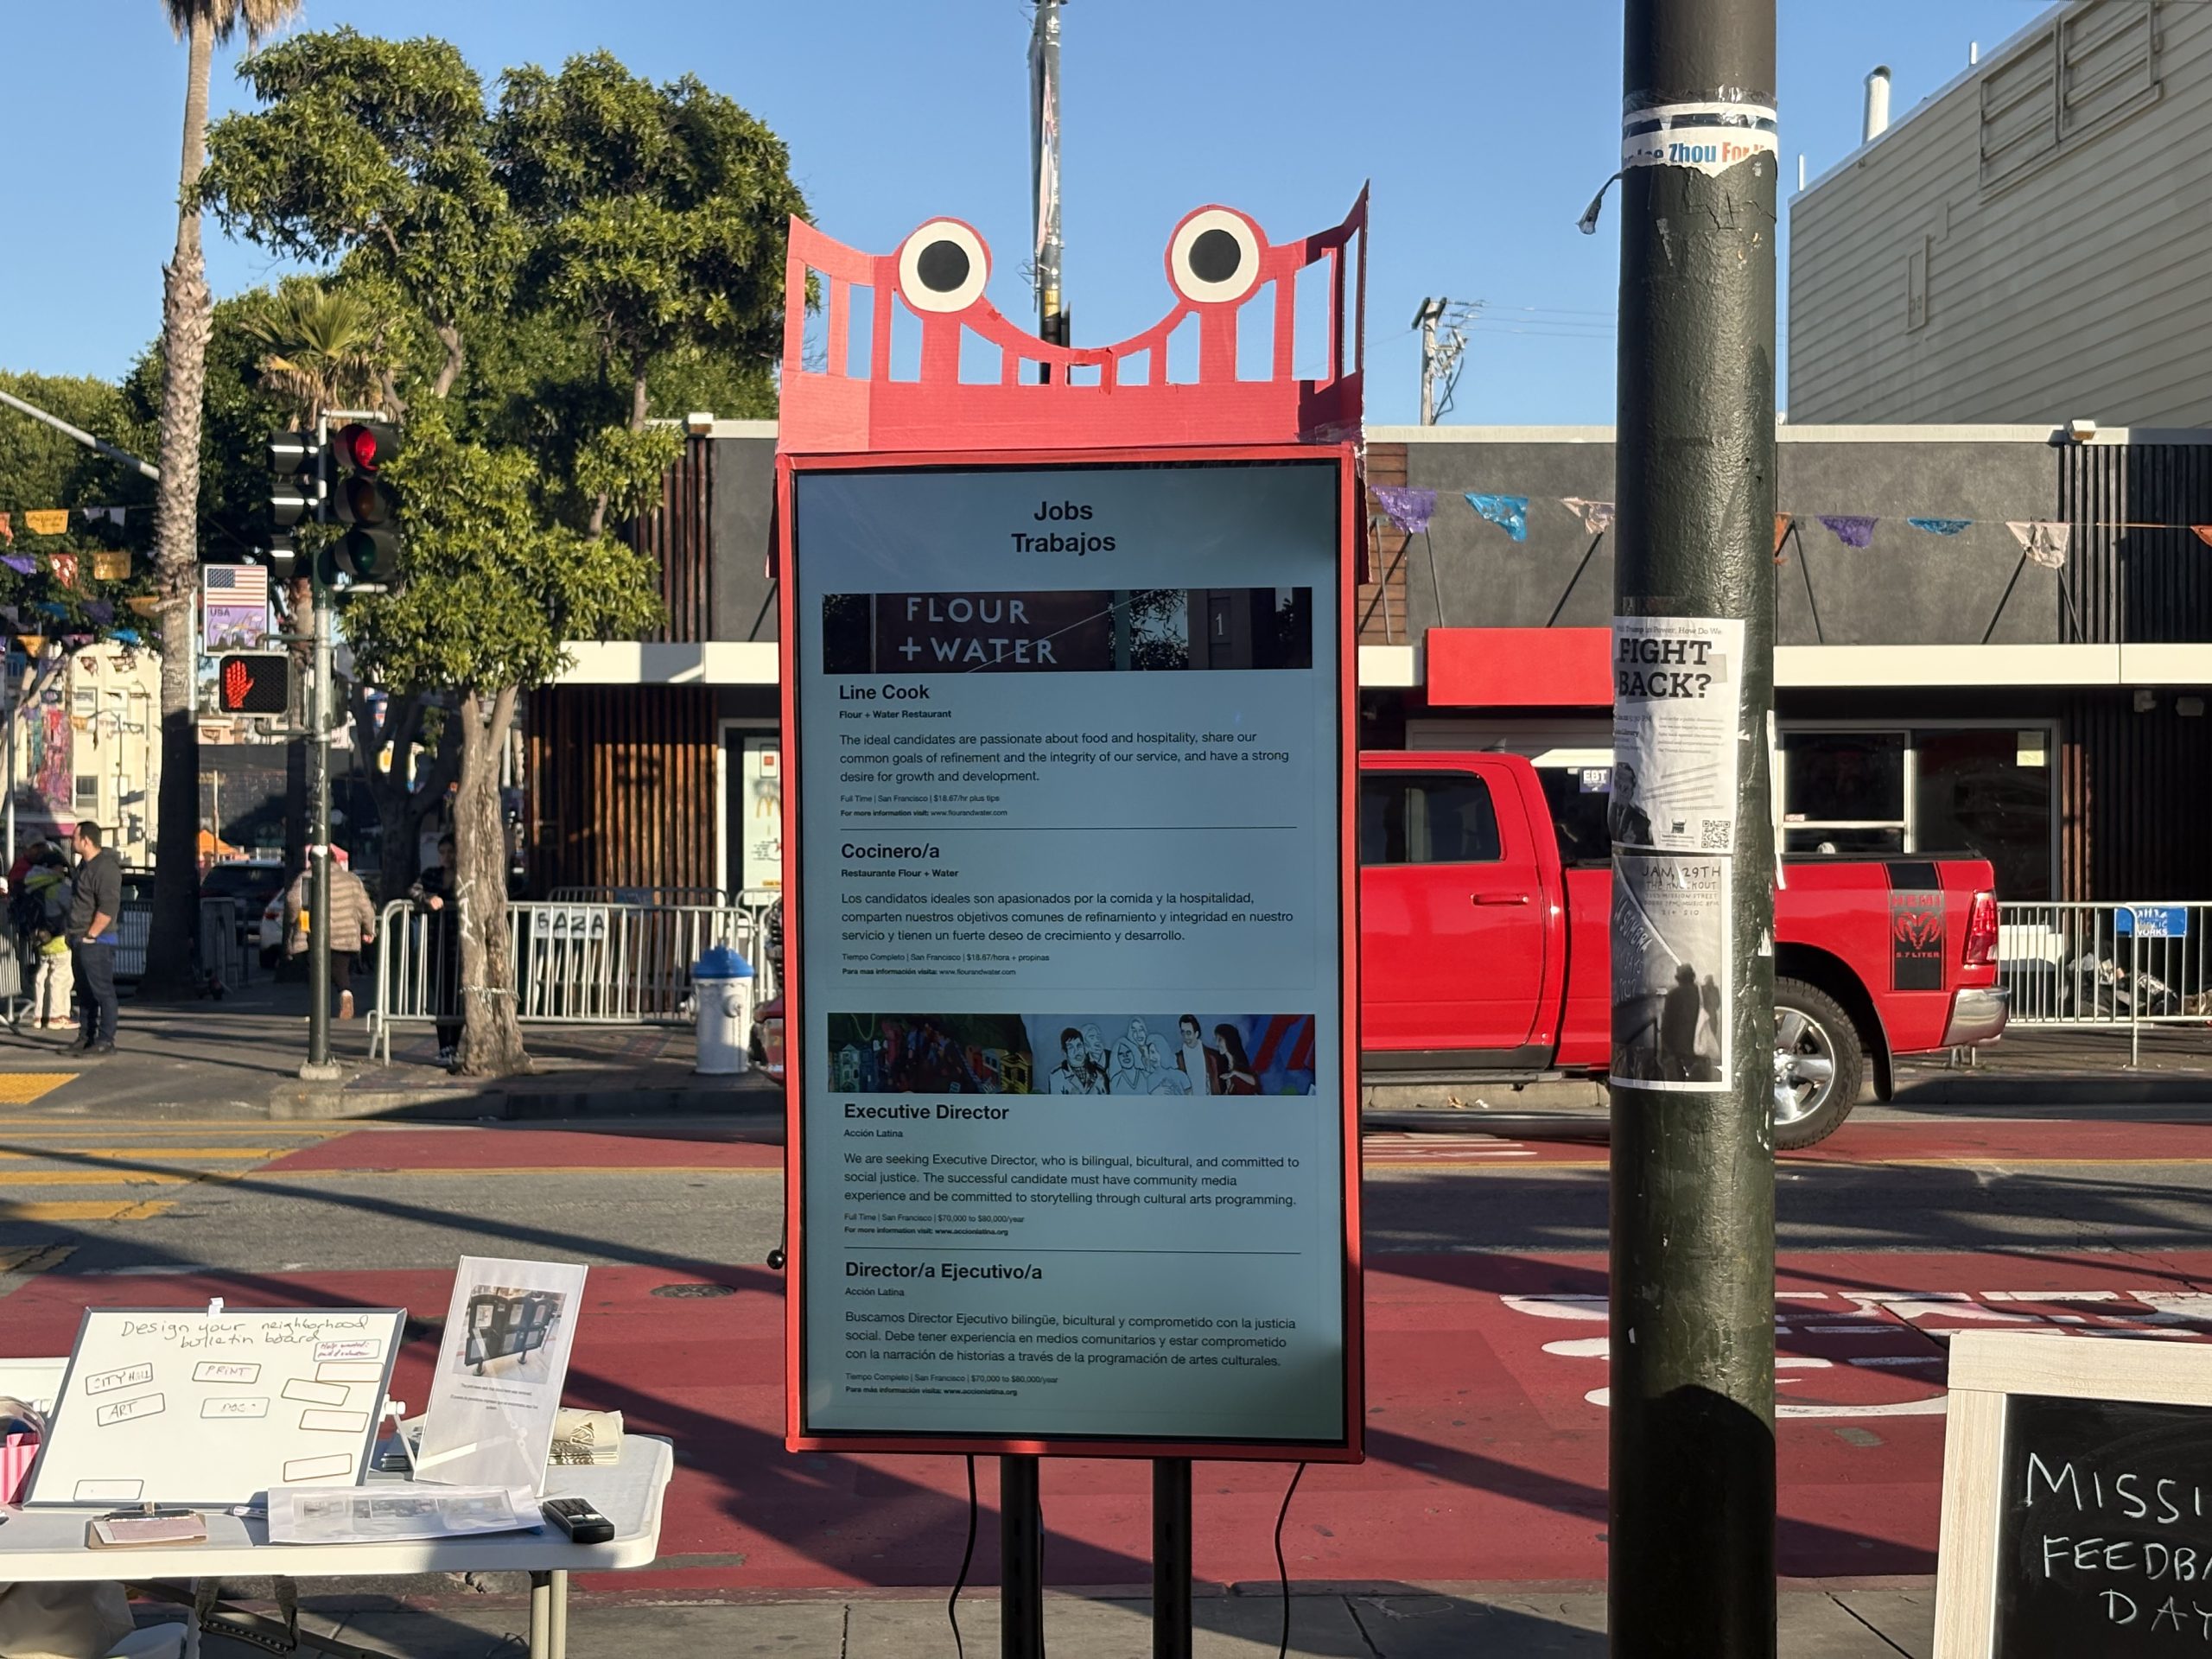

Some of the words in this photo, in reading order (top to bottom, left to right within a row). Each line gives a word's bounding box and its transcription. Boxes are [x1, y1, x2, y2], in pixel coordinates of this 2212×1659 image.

[1669, 142, 1716, 163] Zhou
[1033, 500, 1092, 521] Jobs
[1011, 531, 1116, 556] Trabajos
[210, 607, 231, 617] USA
[906, 597, 1030, 625] FLOUR
[899, 637, 921, 661] +
[930, 638, 1058, 664] WATER
[1619, 638, 1712, 665] FIGHT
[839, 684, 876, 699] Line
[882, 683, 930, 699] Cook
[1619, 671, 1712, 698] BACK?
[901, 709, 951, 718] Restaurant
[839, 734, 861, 745] The
[864, 734, 890, 745] ideal
[893, 734, 956, 744] candidates
[980, 733, 1042, 747] passionate
[1045, 733, 1078, 743] about
[1081, 733, 1108, 743] food
[1111, 732, 1133, 742] and
[1137, 732, 1198, 745] hospitality,
[1202, 732, 1234, 742] share
[892, 753, 923, 766] goals
[925, 752, 938, 763] of
[941, 752, 1000, 763] refinement
[1003, 752, 1025, 762] and
[1028, 752, 1046, 762] the
[1050, 751, 1096, 765] integrity
[1099, 751, 1110, 761] of
[1136, 751, 1180, 762] service,
[1184, 750, 1206, 760] and
[1210, 750, 1237, 760] have
[1251, 751, 1288, 762] strong
[840, 772, 874, 782] desire
[877, 771, 893, 781] for
[896, 771, 934, 784] growth
[938, 771, 959, 781] and
[963, 771, 1039, 783] development.
[1583, 769, 1607, 781] EBT
[841, 842, 939, 858] Cocinero/a
[841, 868, 895, 877] Restaurante
[931, 868, 958, 877] Water
[1681, 866, 1721, 878] 29TH
[1646, 881, 1662, 890] THE
[842, 893, 861, 903] Los
[865, 893, 927, 903] candidatos
[931, 893, 970, 903] ideales
[998, 893, 1071, 906] apasionados
[1074, 895, 1094, 906] por
[1096, 893, 1106, 903] la
[1109, 893, 1153, 903] comida
[1155, 895, 1162, 906] y
[1166, 893, 1176, 903] la
[1179, 892, 1254, 906] hospitalidad,
[1891, 893, 1942, 907] HEMI
[844, 1103, 931, 1119] Executive
[937, 1104, 1009, 1119] Director
[843, 1128, 874, 1137] Acción
[844, 1153, 861, 1163] We
[886, 1154, 929, 1166] seeking
[932, 1154, 987, 1165] Executive
[991, 1154, 1037, 1166] Director,
[1041, 1155, 1065, 1165] who
[1069, 1155, 1078, 1165] is
[1082, 1155, 1132, 1168] bilingual,
[1136, 1155, 1192, 1168] bicultural,
[1196, 1157, 1217, 1166] and
[1222, 1157, 1283, 1166] committed
[1287, 1158, 1300, 1167] to
[844, 1172, 876, 1181] social
[880, 1172, 919, 1184] justice.
[923, 1172, 944, 1183] The
[947, 1173, 1007, 1183] successful
[1011, 1173, 1067, 1184] candidate
[1071, 1175, 1099, 1184] must
[1103, 1174, 1130, 1185] have
[1133, 1175, 1197, 1187] community
[1201, 1175, 1236, 1185] media
[844, 1190, 906, 1202] experience
[909, 1191, 930, 1201] and
[933, 1191, 948, 1201] be
[951, 1192, 1012, 1202] committed
[1015, 1192, 1027, 1202] to
[1030, 1192, 1092, 1205] storytelling
[1096, 1192, 1140, 1205] through
[1143, 1193, 1185, 1204] cultural
[1189, 1194, 1211, 1204] arts
[1215, 1194, 1295, 1207] programming.
[846, 1262, 935, 1277] Director/a
[941, 1263, 1042, 1281] Ejecutivo/a
[844, 1287, 874, 1295] Acción
[877, 1287, 905, 1296] Latina
[121, 1320, 189, 1340] Design
[199, 1323, 246, 1339] your
[264, 1331, 321, 1344] board
[108, 1401, 137, 1420] ART
[2025, 1452, 2202, 1524] MISSI
